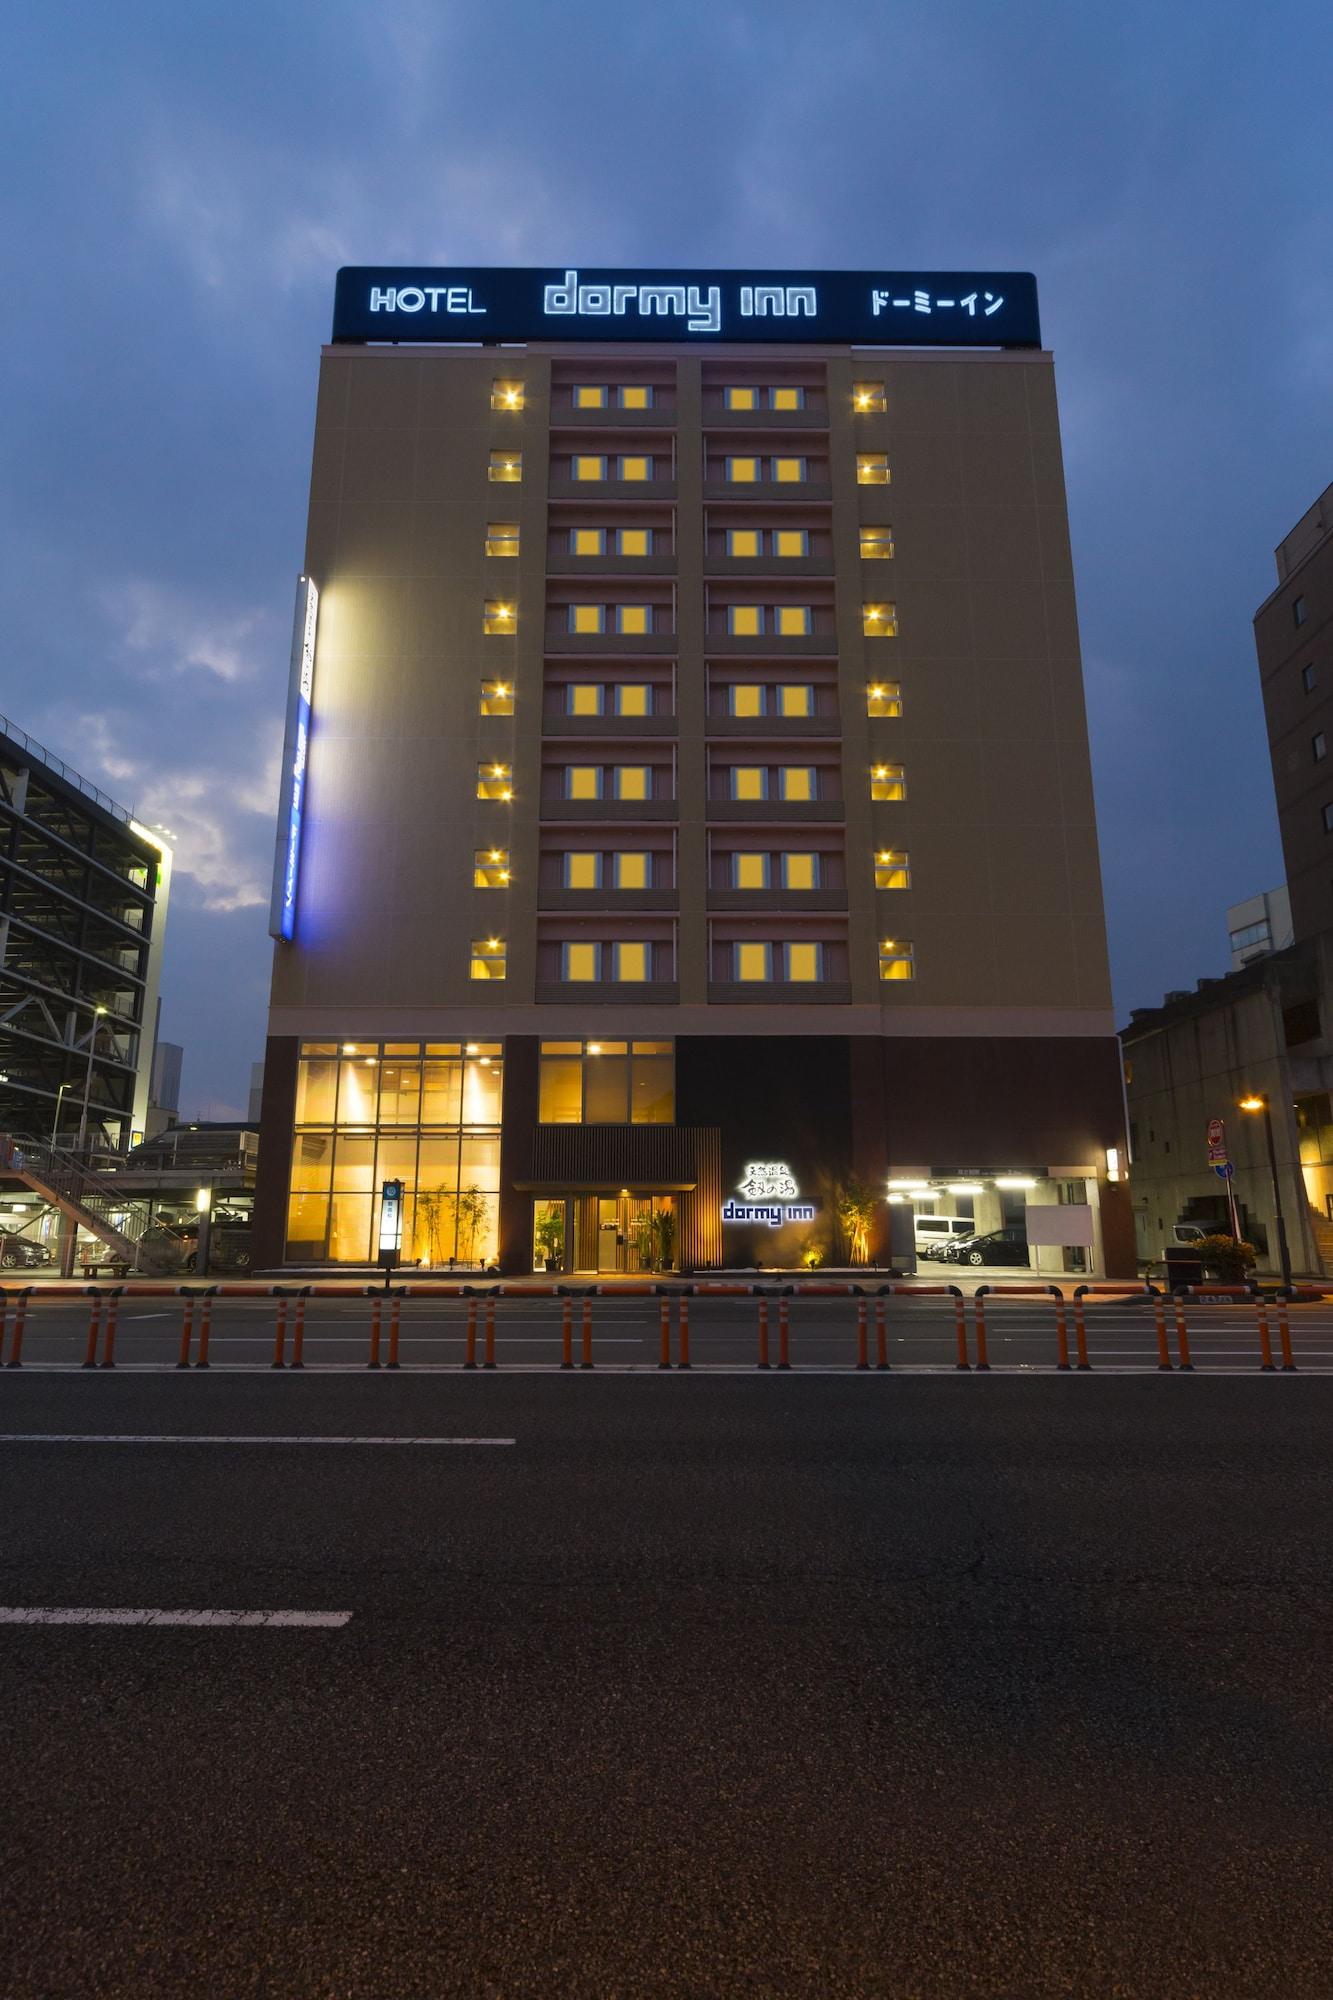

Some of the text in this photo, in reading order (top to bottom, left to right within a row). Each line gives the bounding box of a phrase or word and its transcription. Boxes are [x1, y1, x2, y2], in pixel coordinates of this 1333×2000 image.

[369, 286, 487, 314] HOTEL
[544, 270, 817, 332] dormy inn
[872, 290, 1004, 316] ドーミーイン
[723, 1201, 813, 1226] dormy inn
